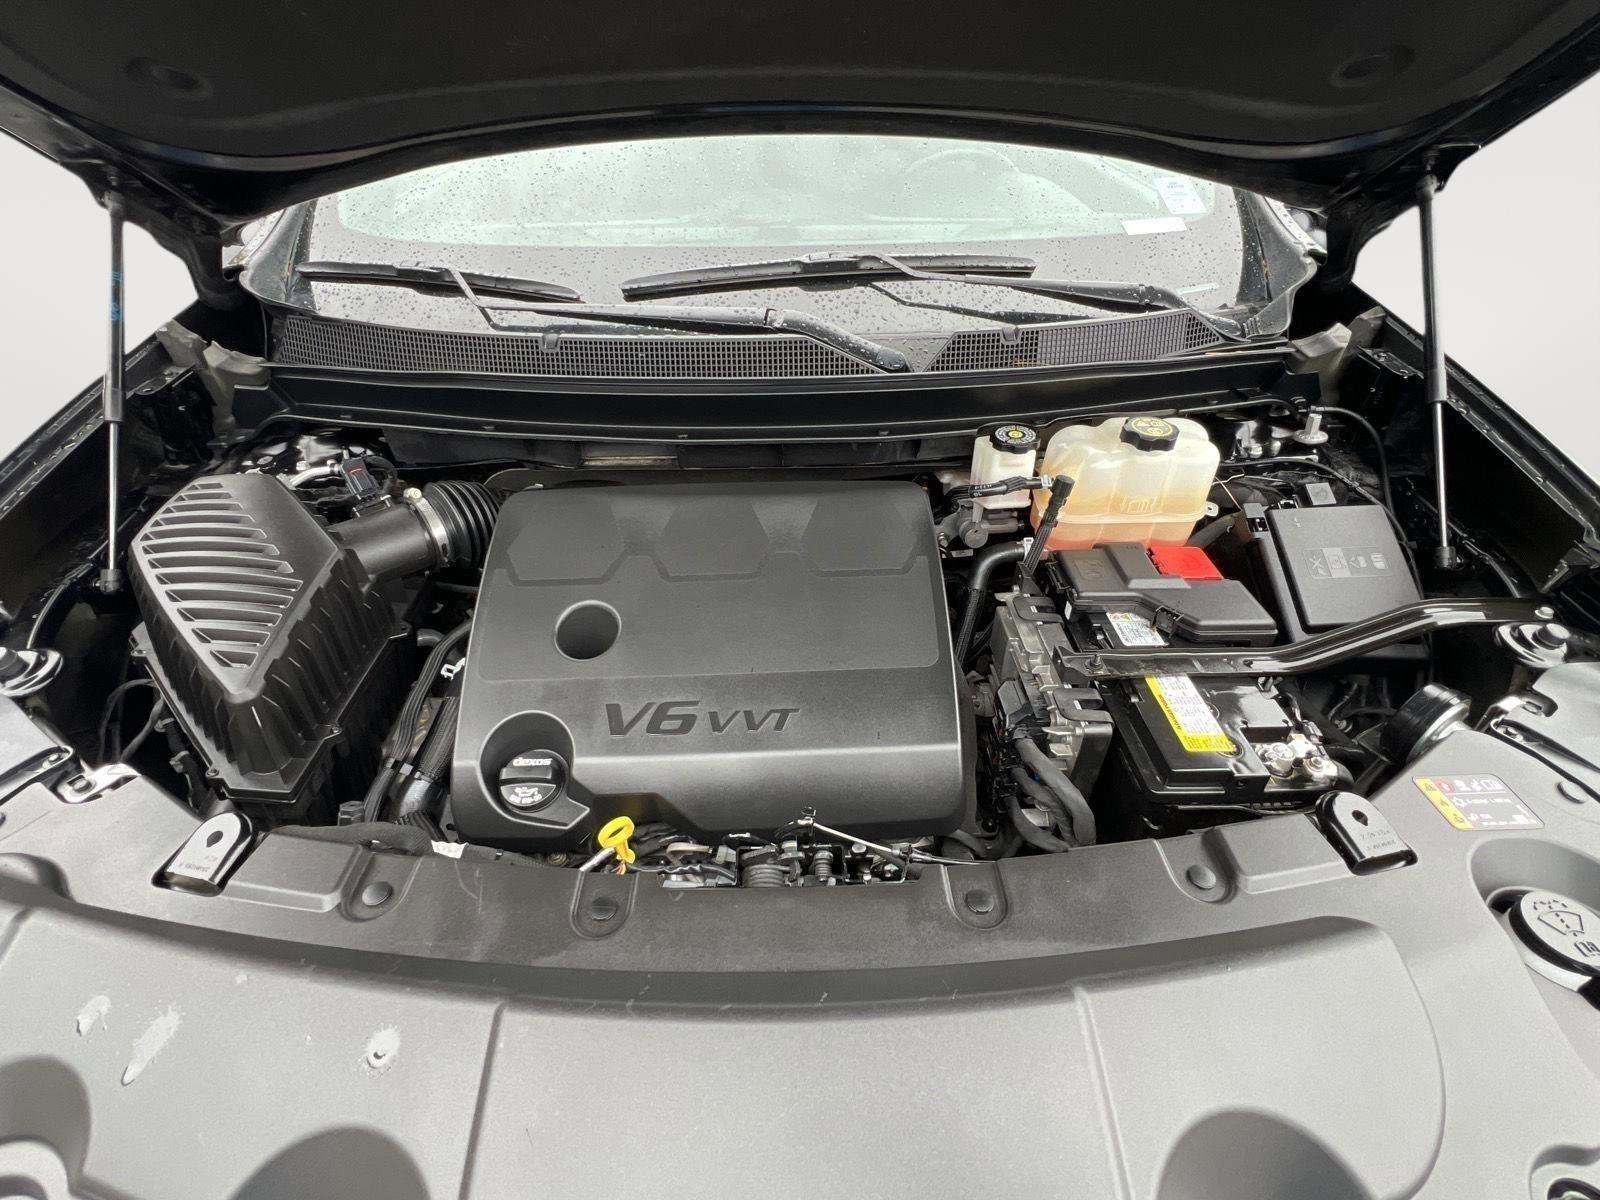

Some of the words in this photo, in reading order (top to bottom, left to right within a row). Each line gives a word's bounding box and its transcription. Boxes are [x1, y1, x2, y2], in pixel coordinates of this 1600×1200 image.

[605, 700, 701, 737] V6
[708, 708, 800, 733] VVT
[513, 757, 553, 767] dexos
